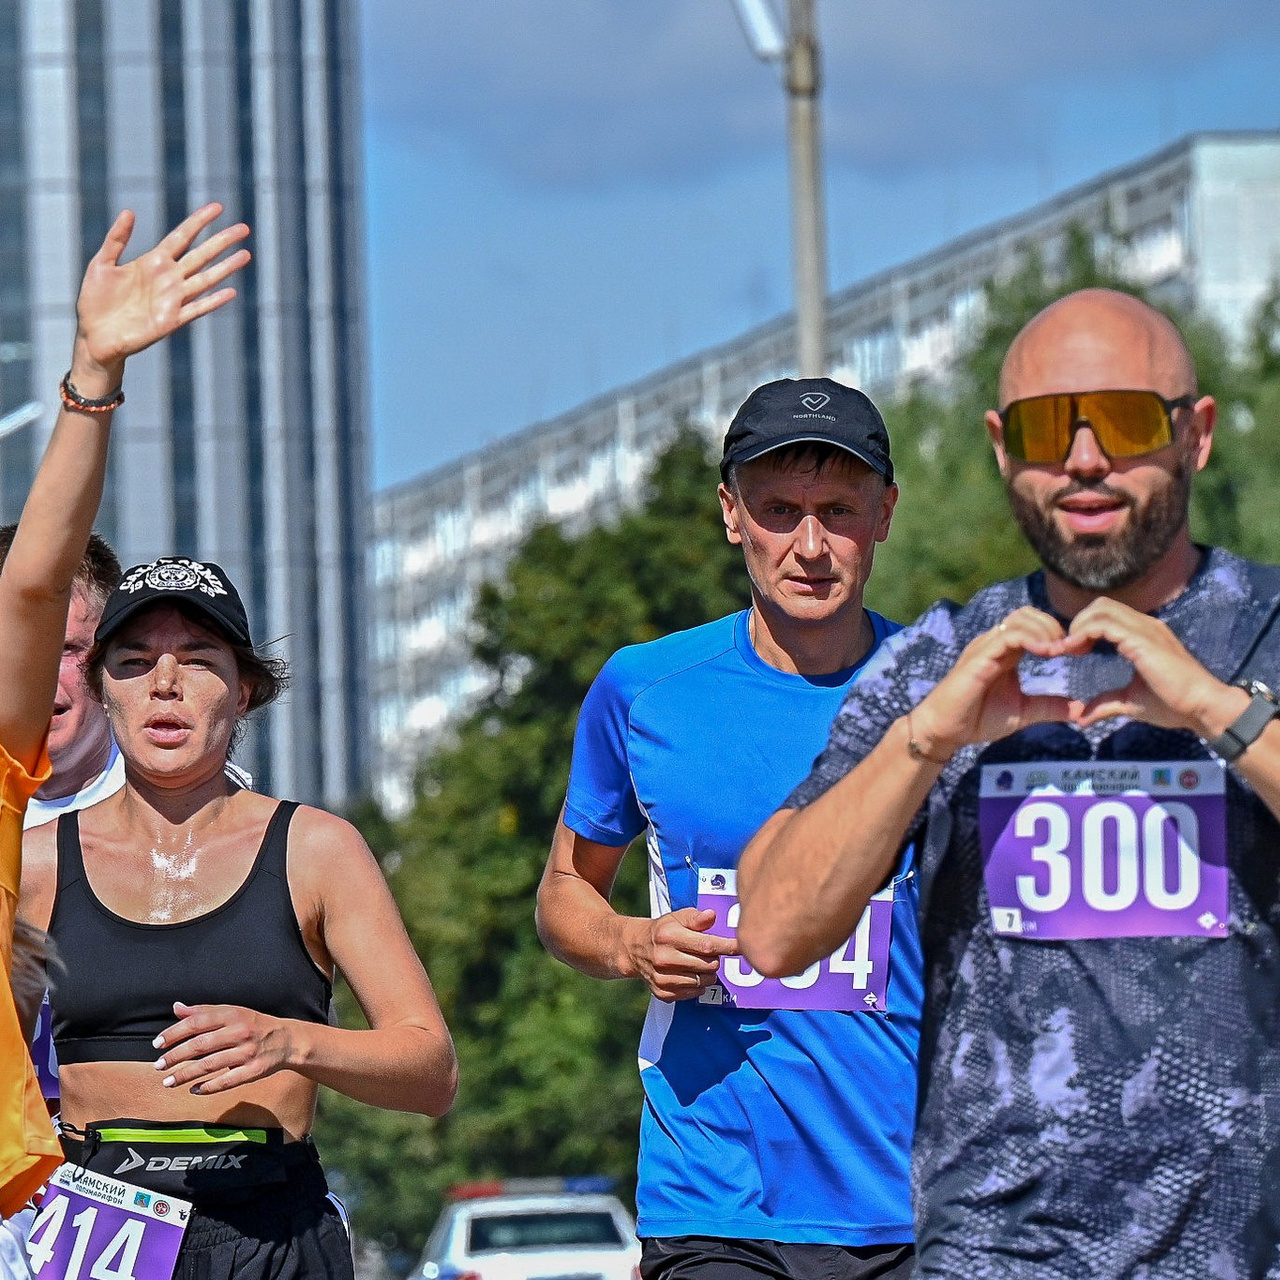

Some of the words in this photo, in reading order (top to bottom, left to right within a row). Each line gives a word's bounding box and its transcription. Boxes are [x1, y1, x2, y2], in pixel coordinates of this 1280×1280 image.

[792, 413, 836, 422] NORTHLAND
[1014, 801, 1201, 913] 300
[710, 988, 718, 1001] 7
[145, 1154, 248, 1171] DEMIX
[76, 1175, 127, 1199] АМСКИЙ
